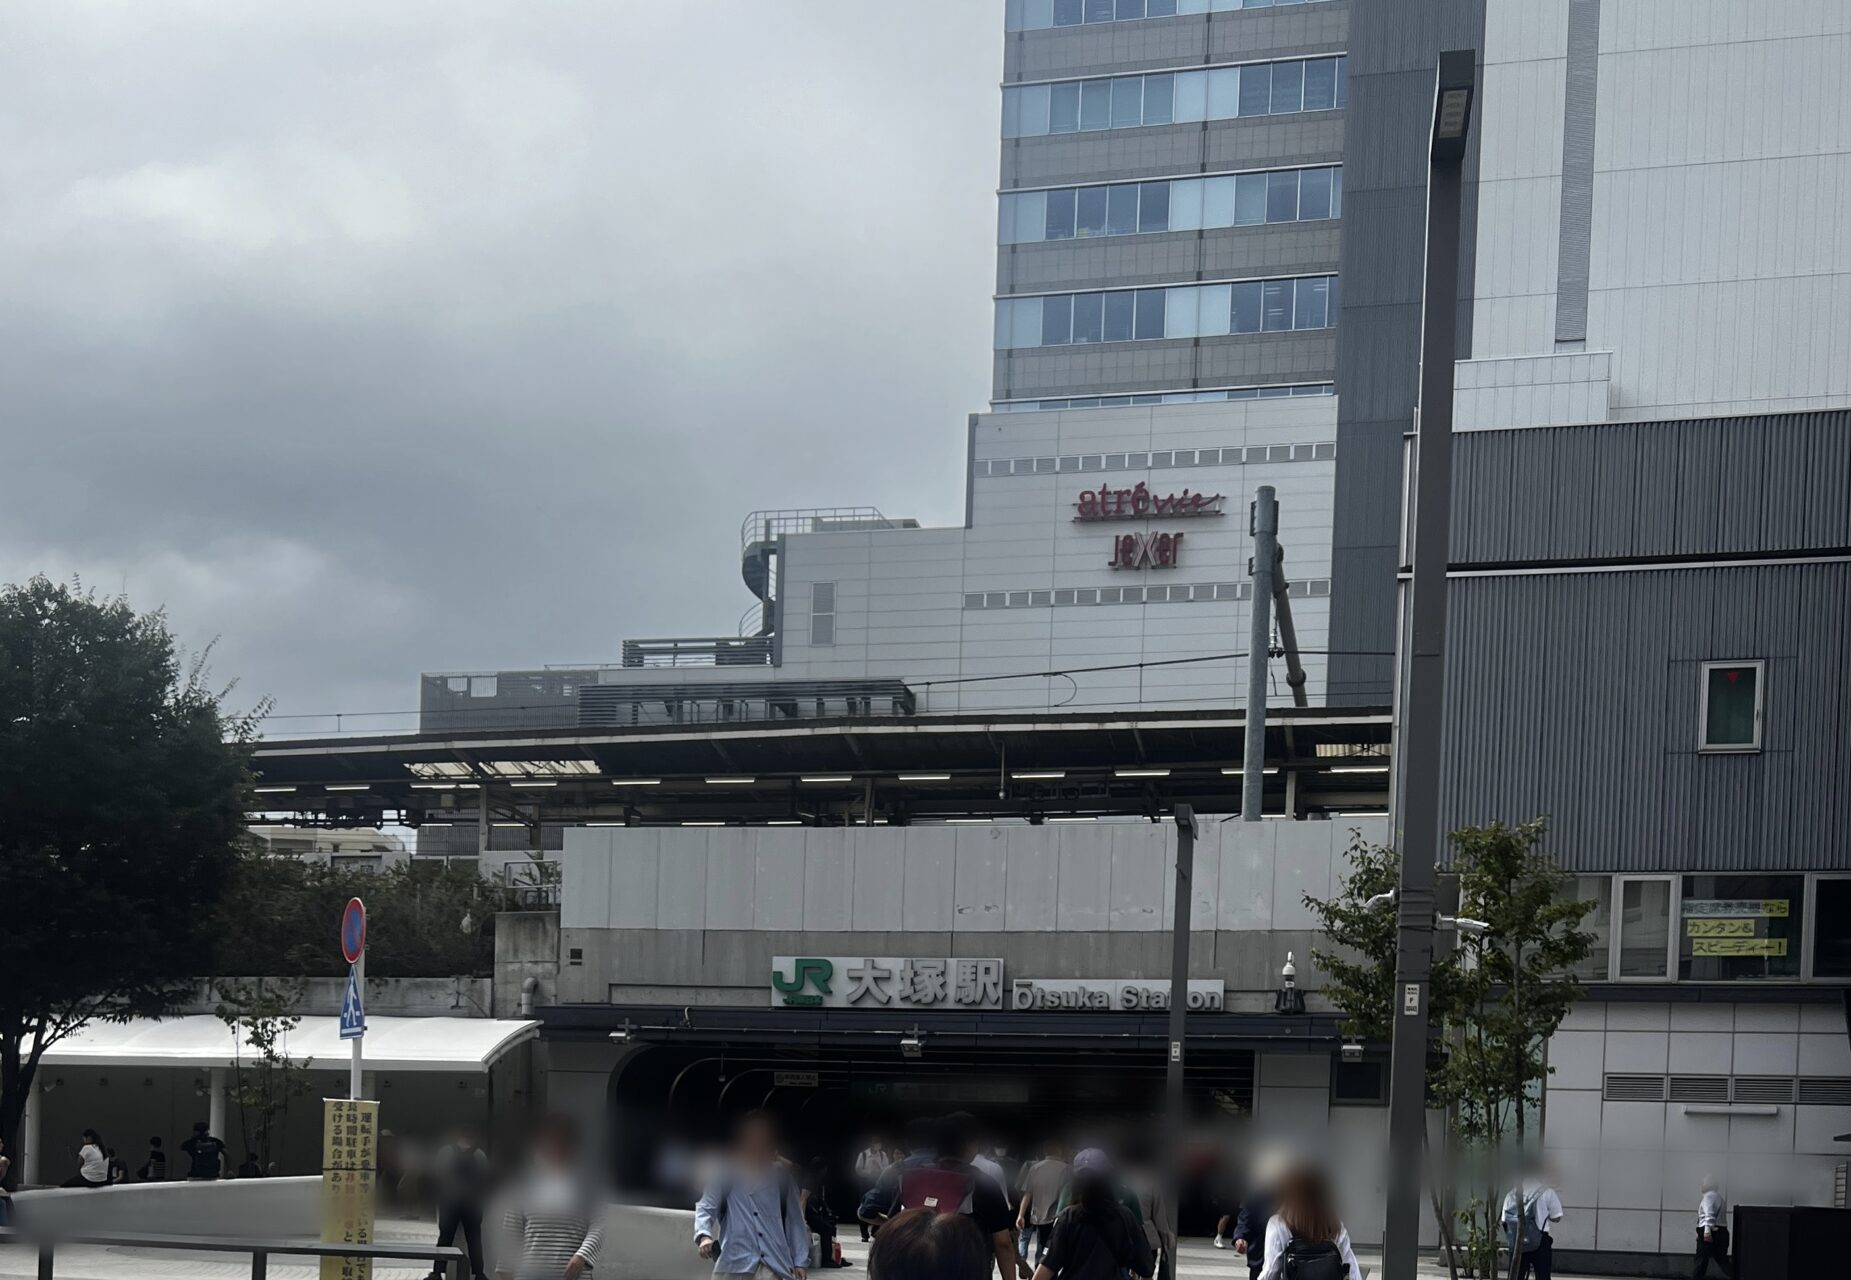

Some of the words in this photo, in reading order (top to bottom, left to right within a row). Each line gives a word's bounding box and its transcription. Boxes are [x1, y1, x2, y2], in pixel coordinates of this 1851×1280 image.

[773, 958, 833, 994] JR
[846, 958, 1000, 1006] 大塚駅
